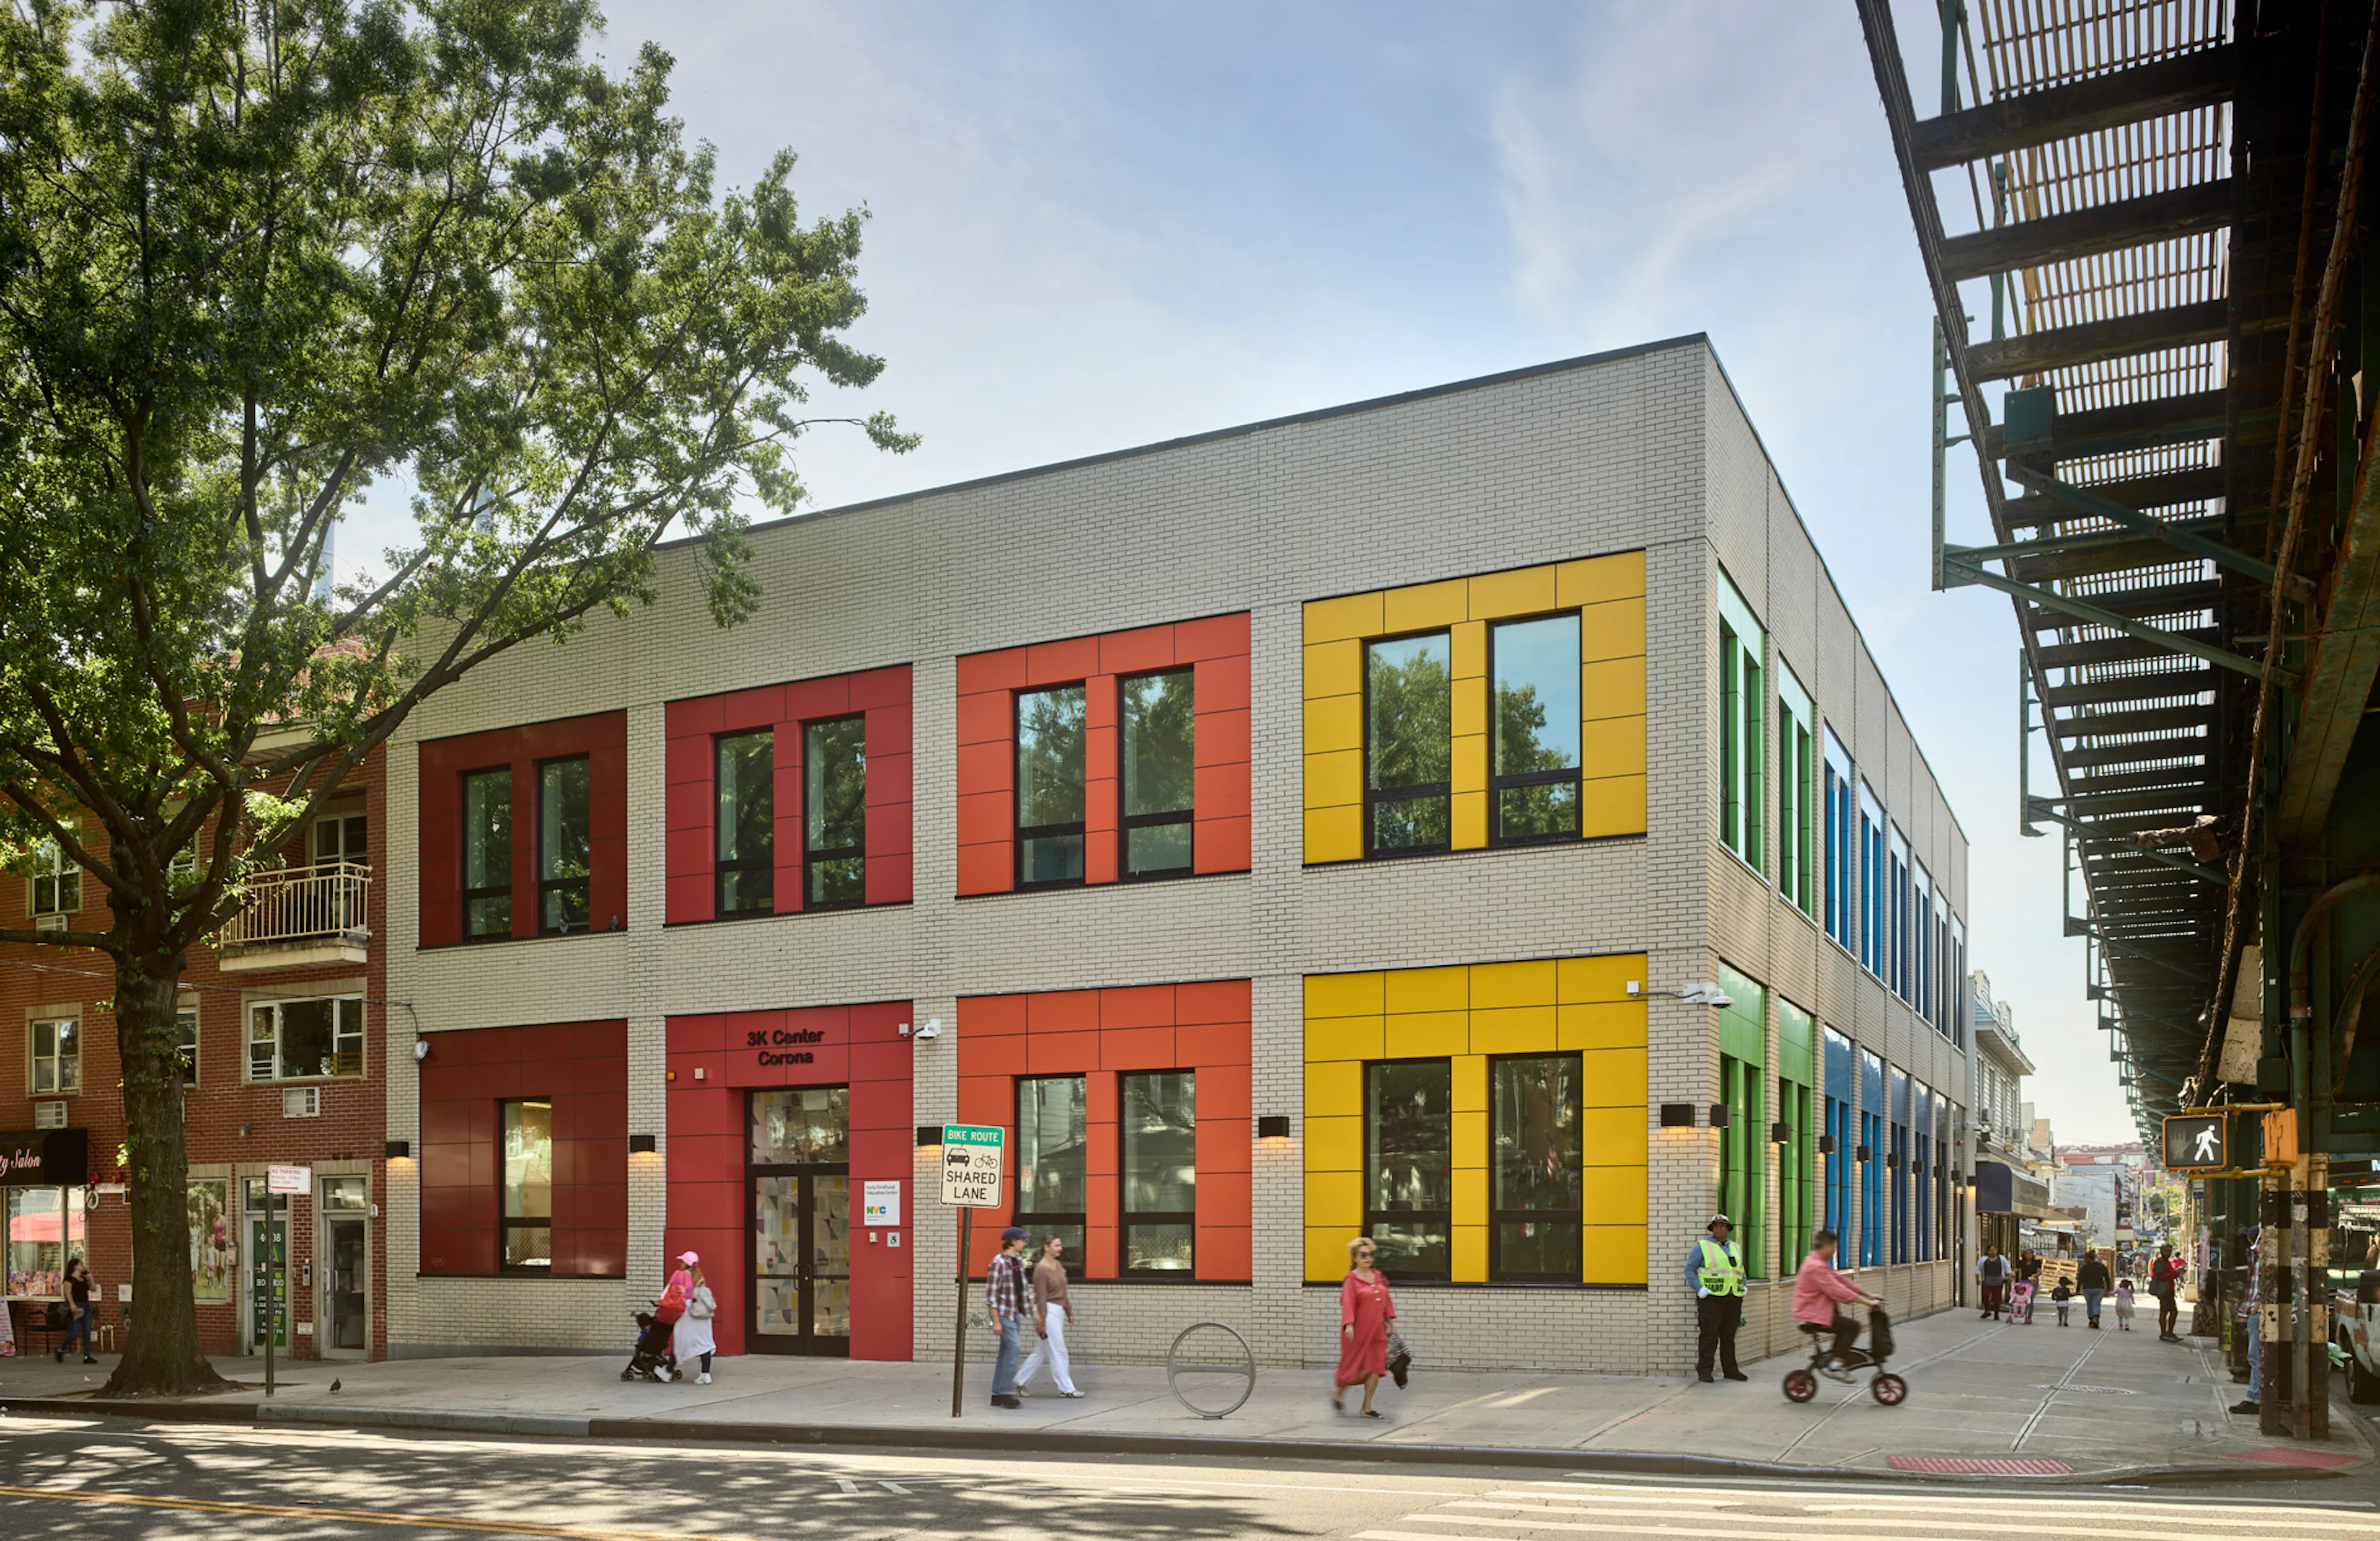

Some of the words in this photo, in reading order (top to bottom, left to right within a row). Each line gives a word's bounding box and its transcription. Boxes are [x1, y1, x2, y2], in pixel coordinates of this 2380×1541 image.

[747, 1030, 768, 1046] 3K
[772, 1028, 825, 1044] Center
[759, 1051, 813, 1066] Corona
[948, 1129, 967, 1141] BIKE
[970, 1131, 998, 1142] ROUTE
[11, 1148, 42, 1168] Salon
[946, 1170, 996, 1185] SHARED
[954, 1186, 987, 1199] LANE
[866, 1206, 886, 1214] NYC
